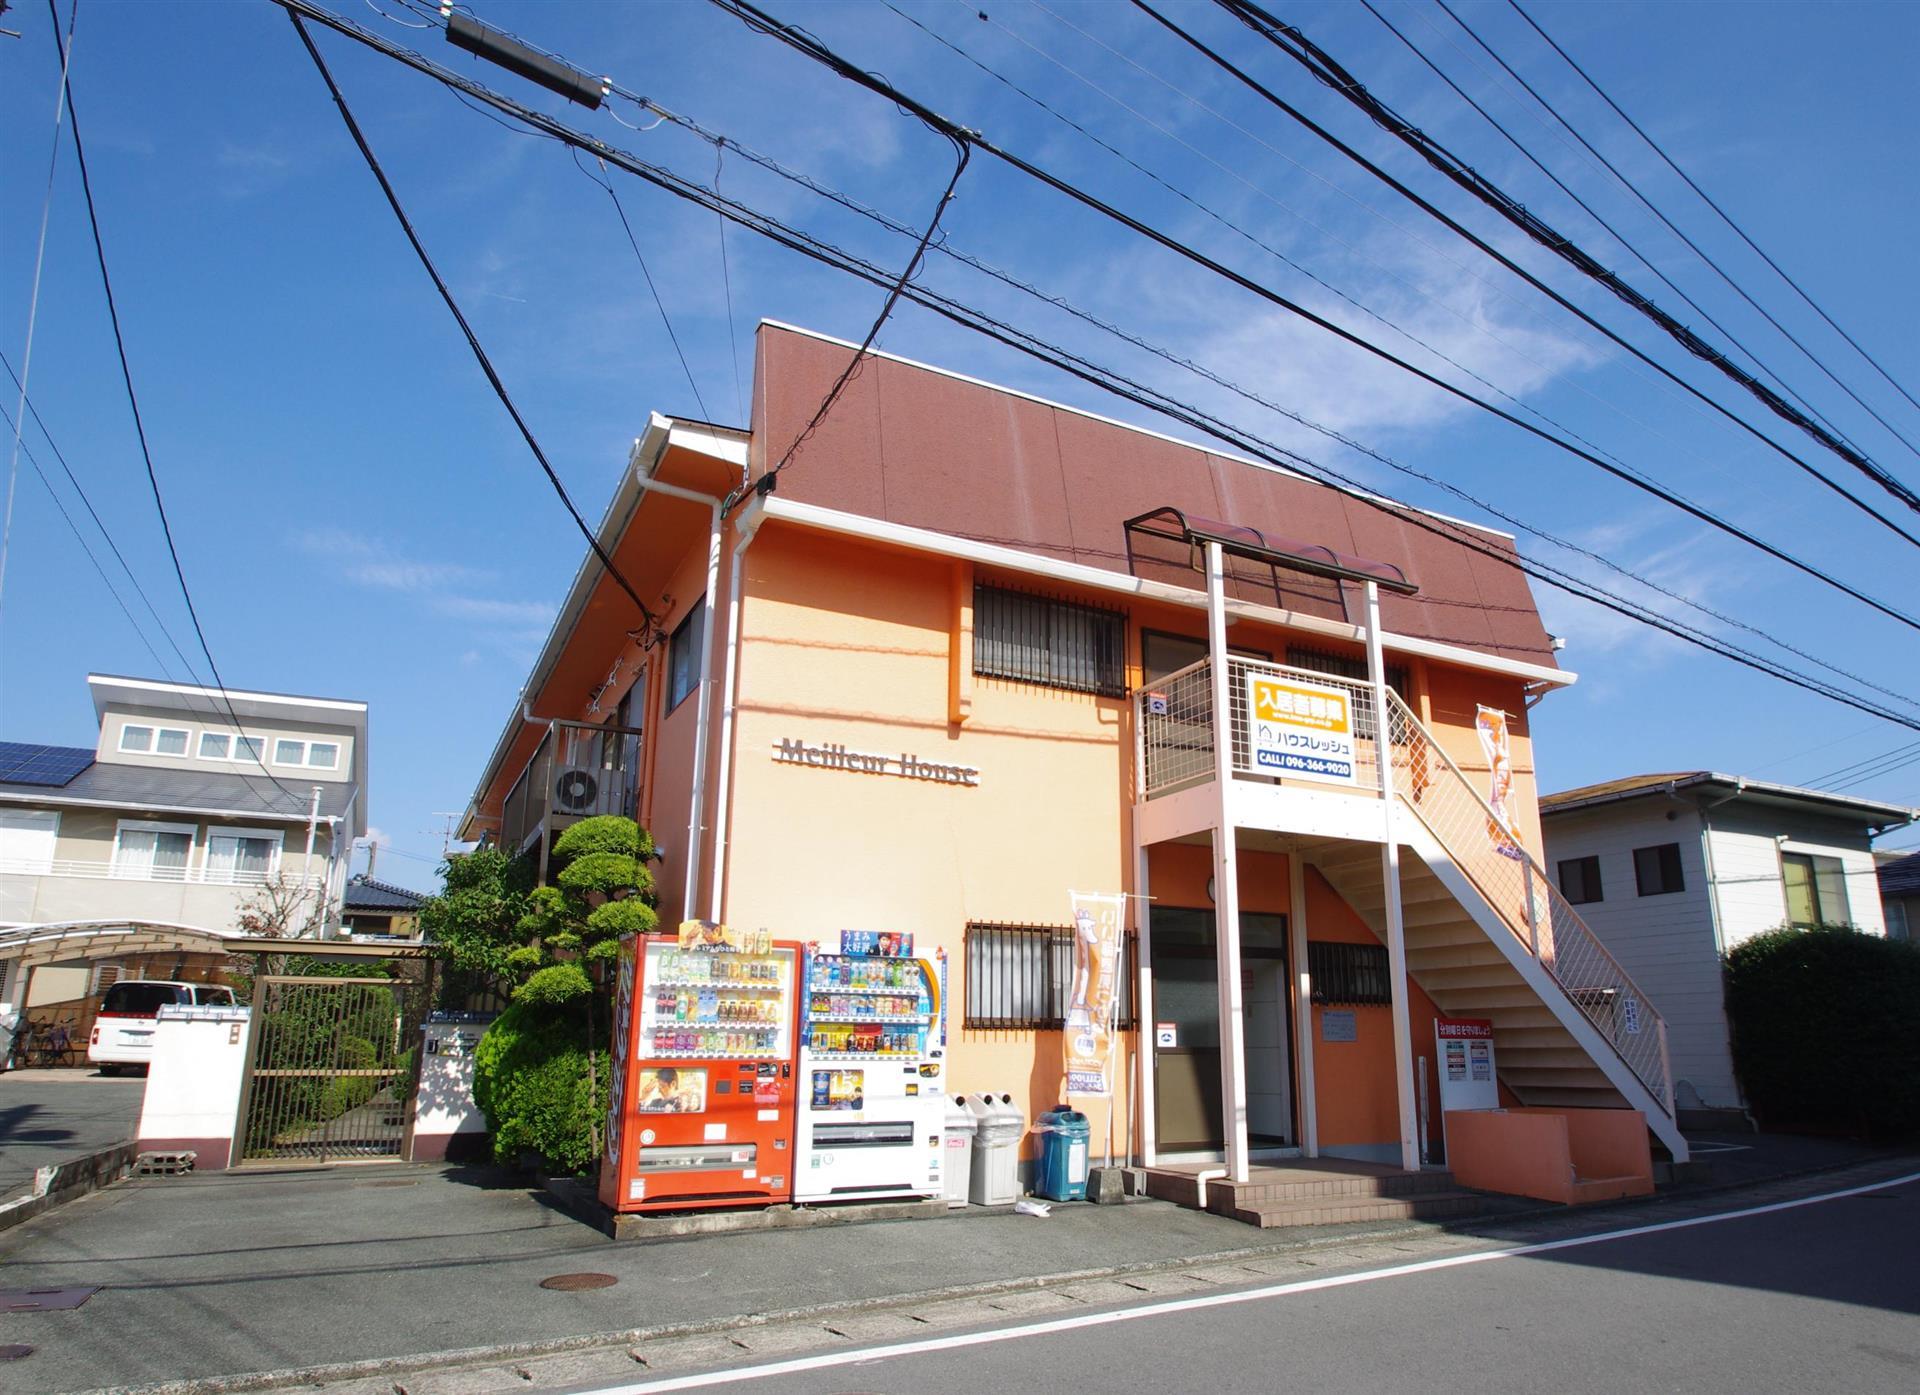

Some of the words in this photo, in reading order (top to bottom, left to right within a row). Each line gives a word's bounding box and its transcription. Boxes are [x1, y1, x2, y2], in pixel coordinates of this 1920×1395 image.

[1259, 686, 1344, 722] 入居者募集
[1277, 731, 1350, 755] ハウスレッシュ
[780, 737, 889, 772] Meilleur
[900, 753, 975, 784] House
[1286, 756, 1350, 775] 096-366-9020
